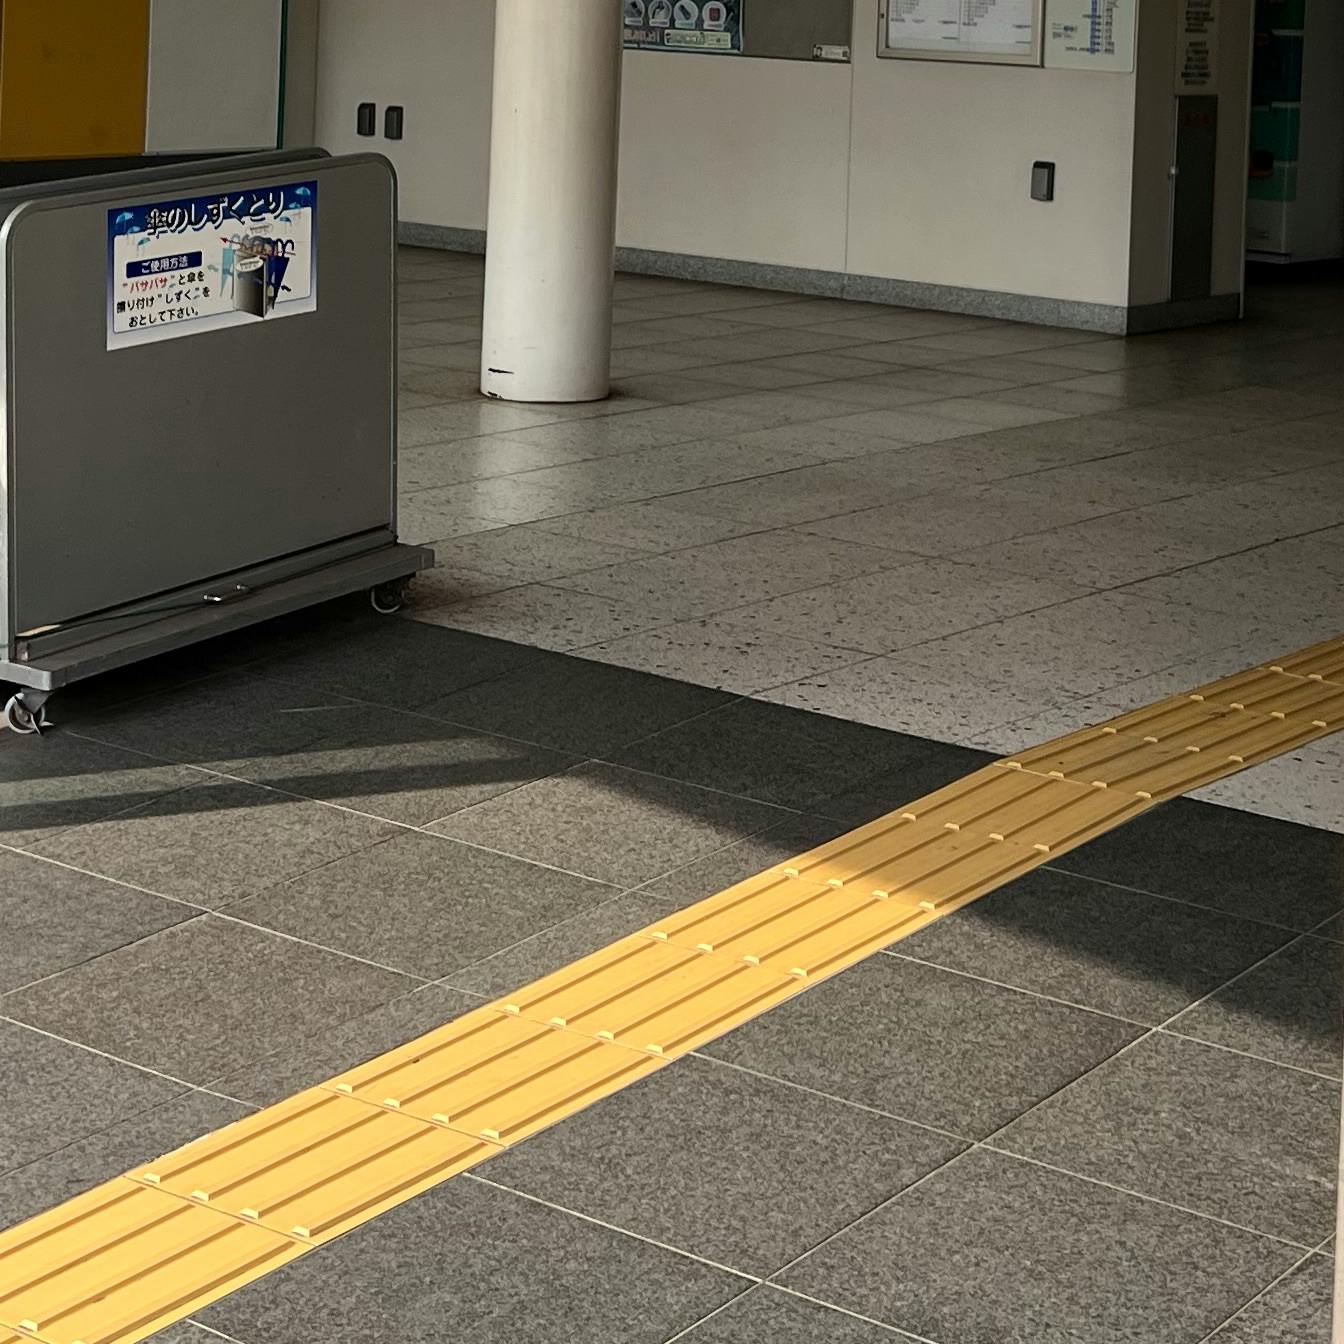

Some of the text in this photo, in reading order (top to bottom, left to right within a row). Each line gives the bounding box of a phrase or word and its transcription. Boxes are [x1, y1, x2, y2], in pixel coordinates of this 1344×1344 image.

[145, 191, 286, 239] 傘のしずくとり
[141, 255, 189, 274] ご使用方法
[128, 306, 199, 328] おとして下さい。
